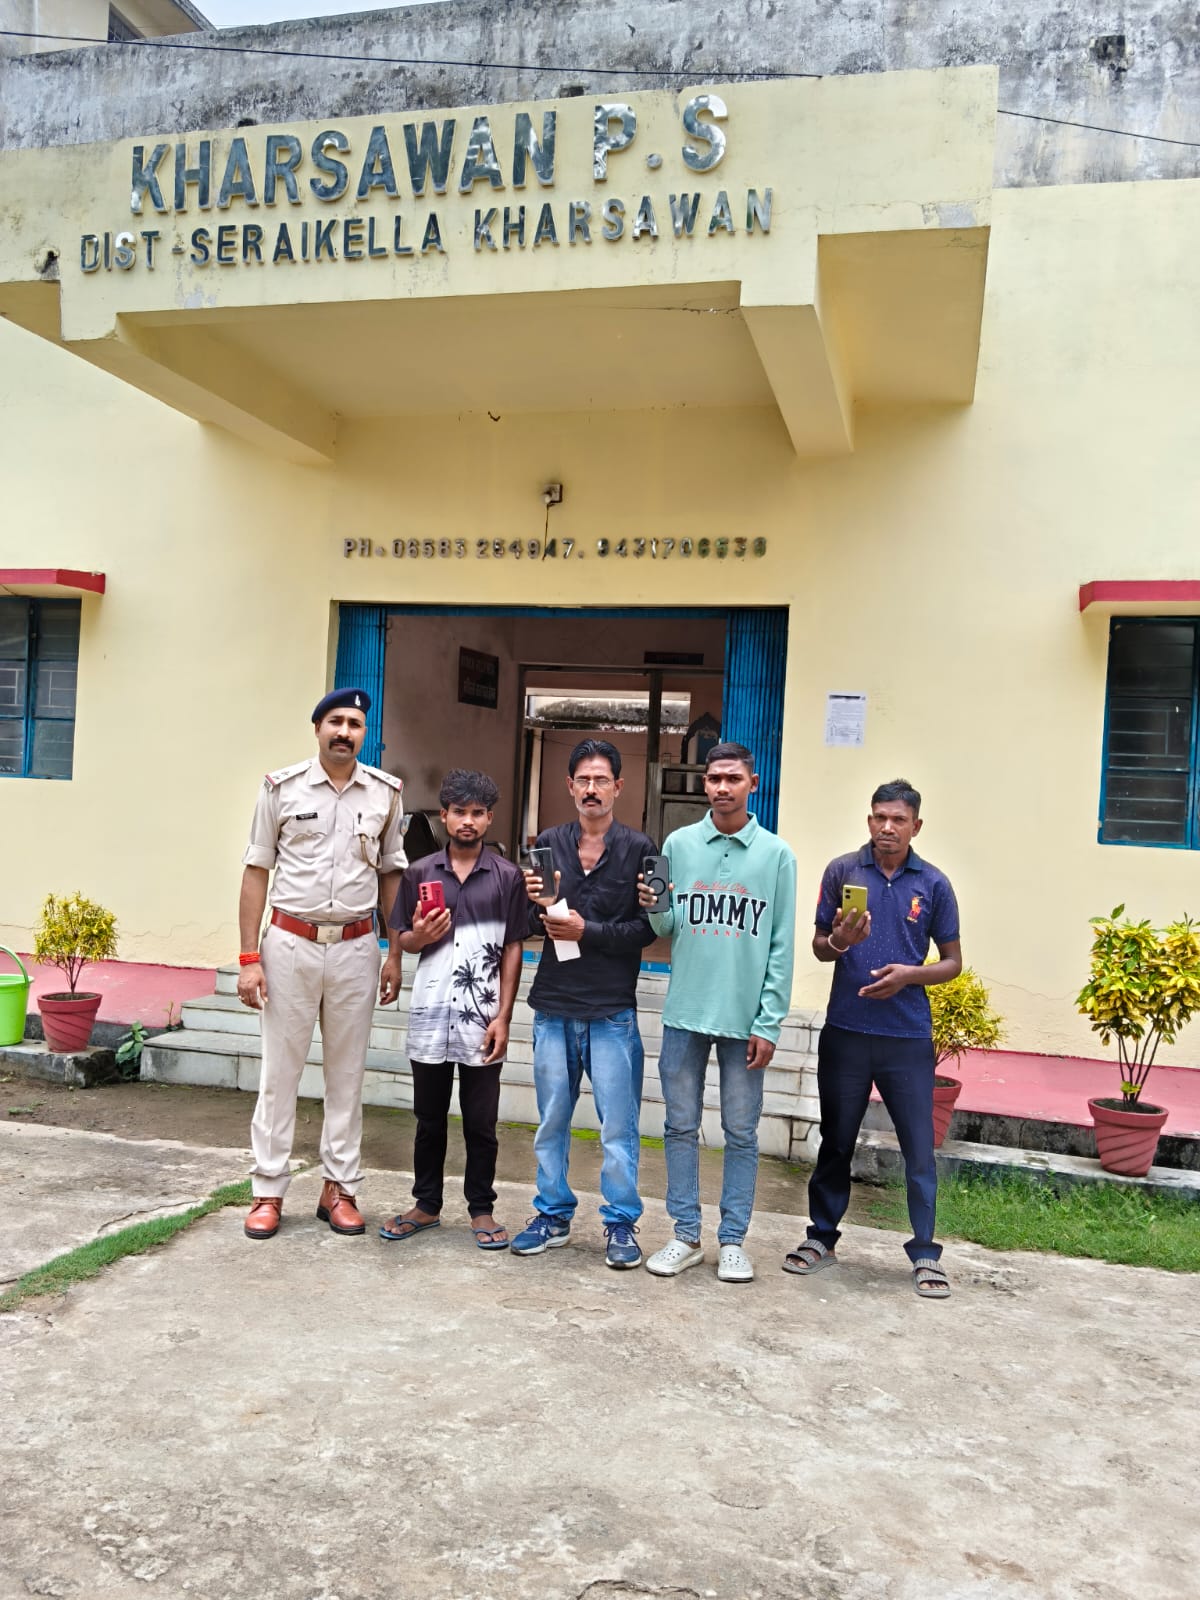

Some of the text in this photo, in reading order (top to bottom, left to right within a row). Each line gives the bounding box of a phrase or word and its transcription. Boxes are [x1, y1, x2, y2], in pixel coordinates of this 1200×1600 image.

[130, 110, 557, 214] KHARSAWAN
[473, 187, 773, 251] KHARSAWAN
[677, 893, 767, 937] TOMMY
